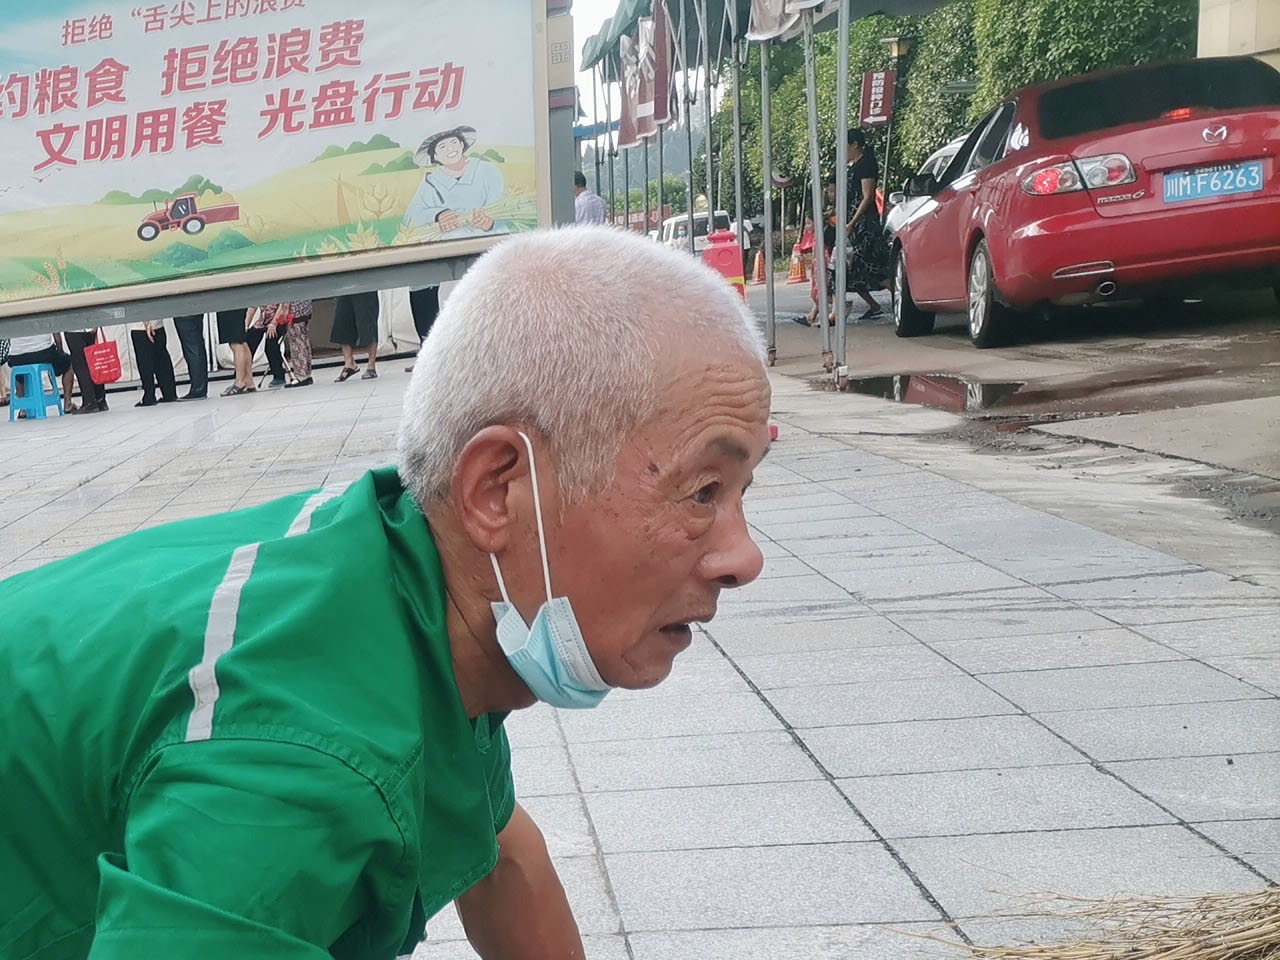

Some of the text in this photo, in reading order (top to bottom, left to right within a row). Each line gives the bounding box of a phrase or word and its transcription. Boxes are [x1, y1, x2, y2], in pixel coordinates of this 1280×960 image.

[61, 13, 114, 46] 拒绝
[161, 18, 366, 97] 拒绝浪费
[33, 62, 465, 171] 文明用餐 光盘行动
